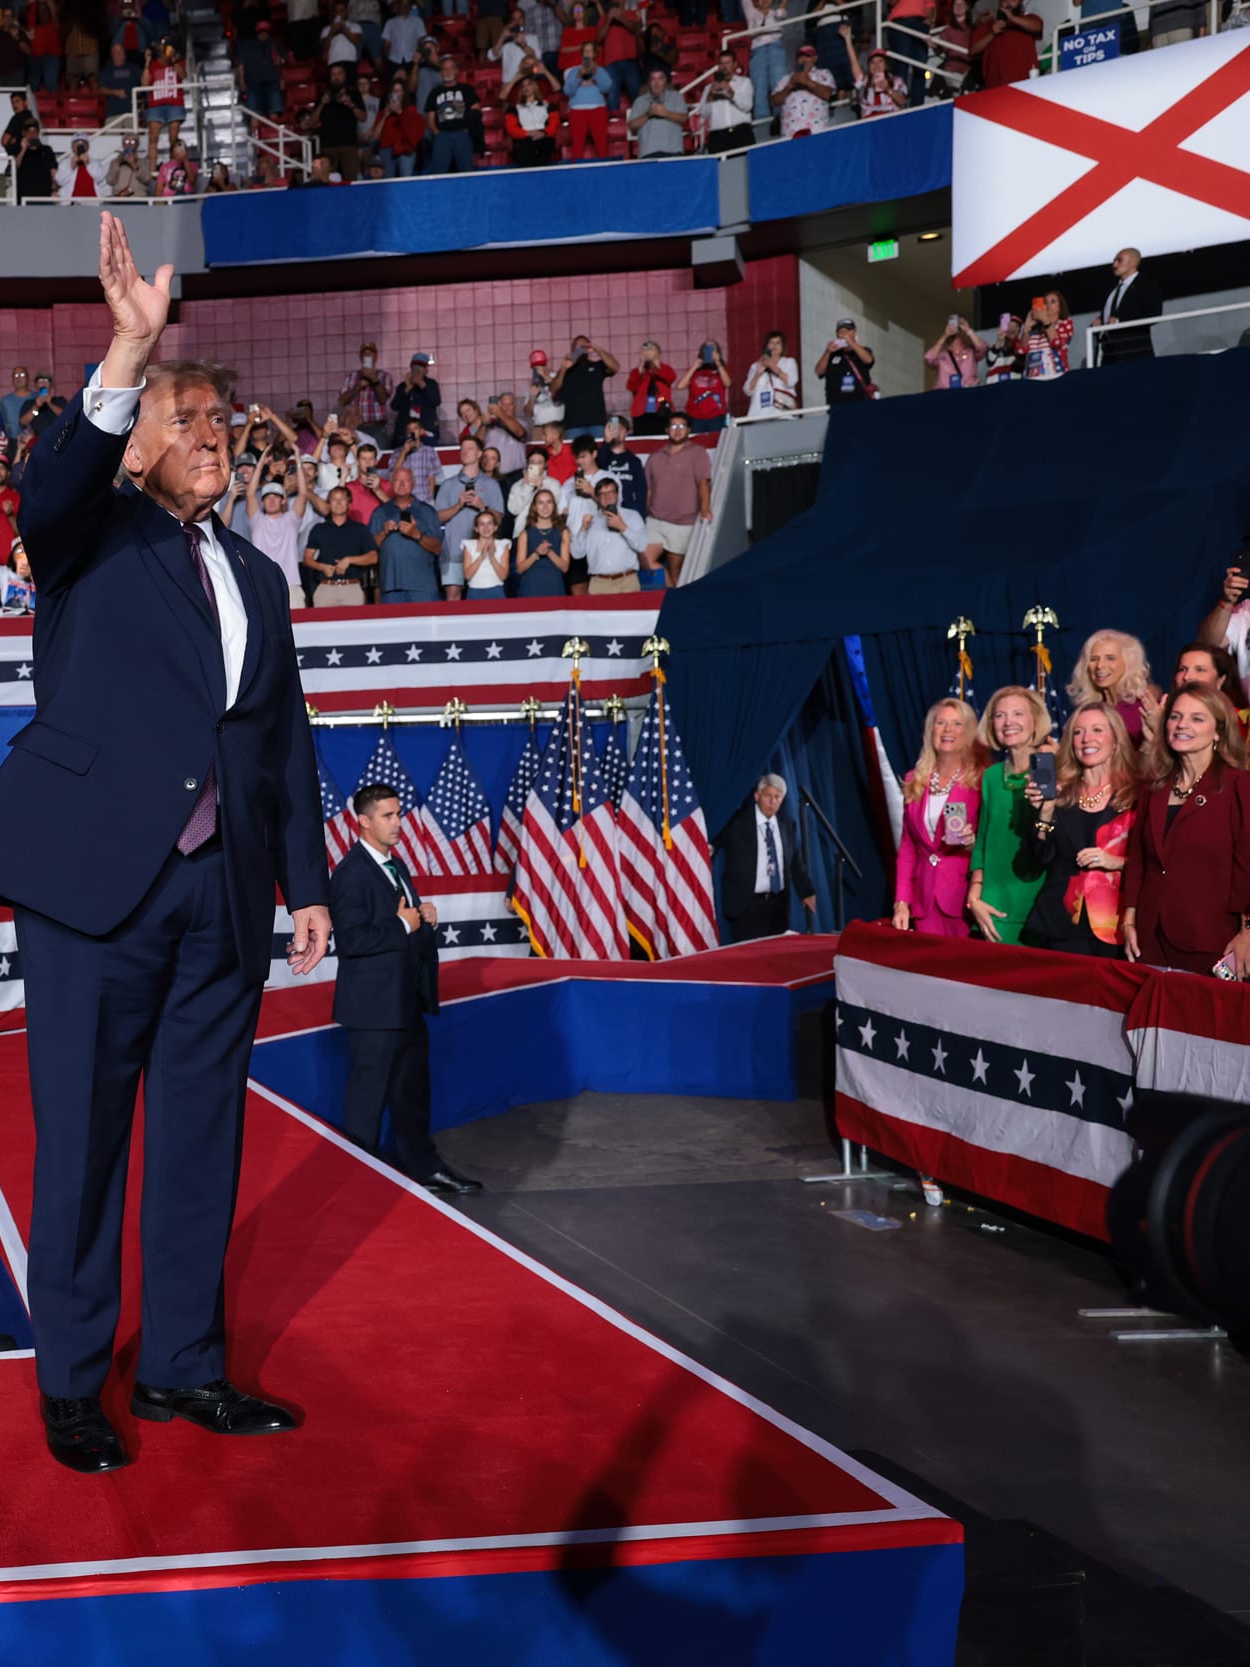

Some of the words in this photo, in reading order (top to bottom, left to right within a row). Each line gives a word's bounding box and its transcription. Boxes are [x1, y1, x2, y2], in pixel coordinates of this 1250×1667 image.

[1063, 38, 1085, 51] NO
[1088, 30, 1115, 44] TAX
[1083, 45, 1096, 54] ON
[1074, 50, 1105, 65] TIPS
